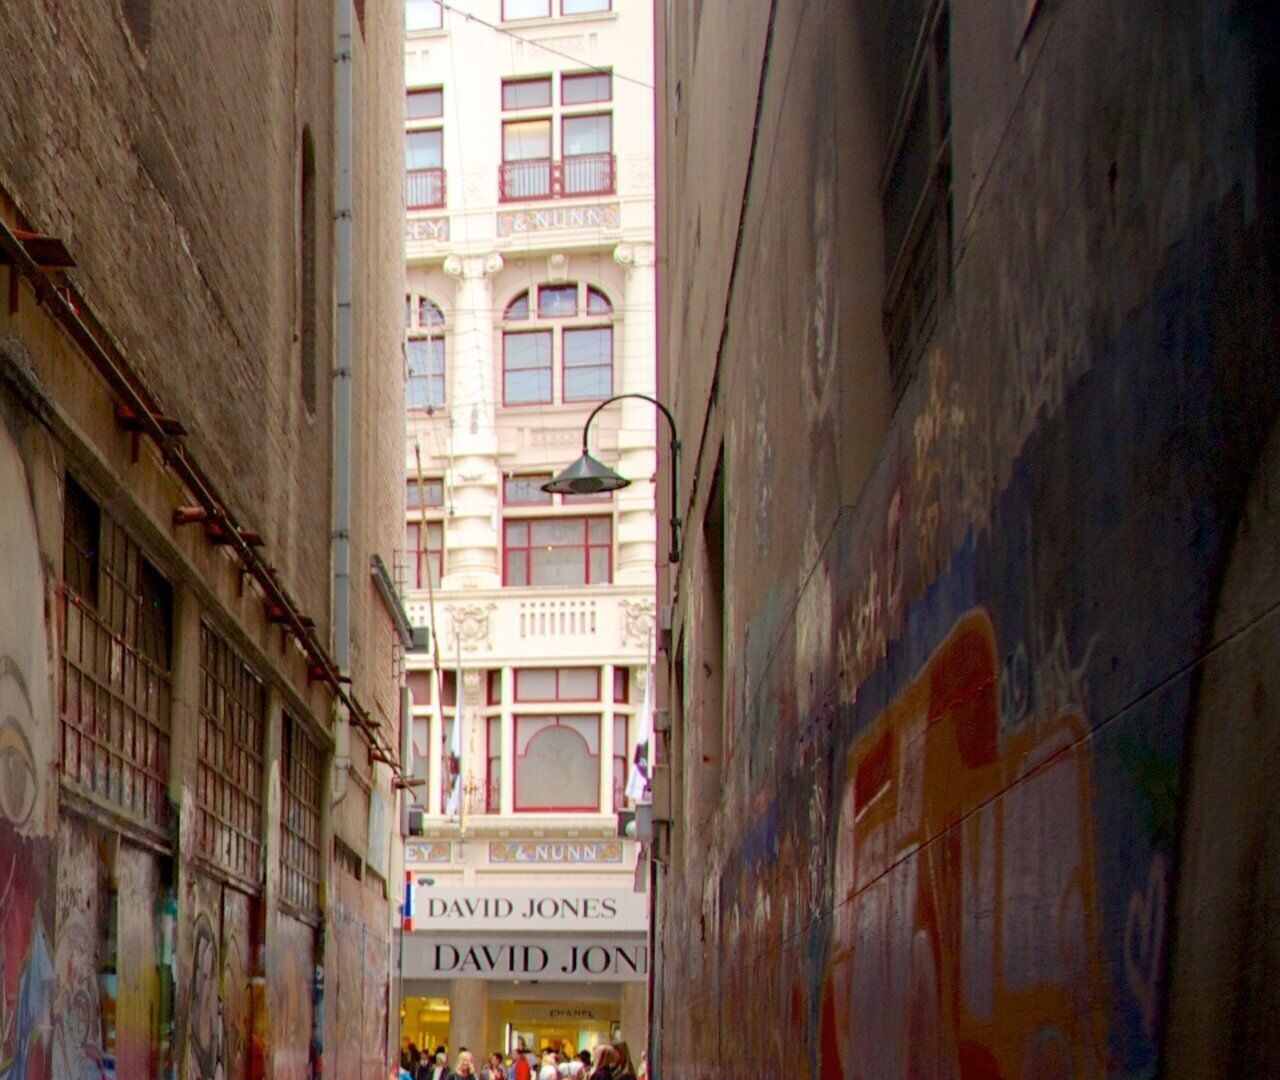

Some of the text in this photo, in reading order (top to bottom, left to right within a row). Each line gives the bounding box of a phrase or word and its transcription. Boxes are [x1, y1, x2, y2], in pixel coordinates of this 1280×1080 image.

[514, 217, 527, 231] &
[535, 208, 600, 229] NUNN
[515, 847, 529, 861] &
[535, 847, 597, 861] NUNN
[428, 898, 617, 919] DAVID JONES
[433, 943, 648, 974] DAVID JON
